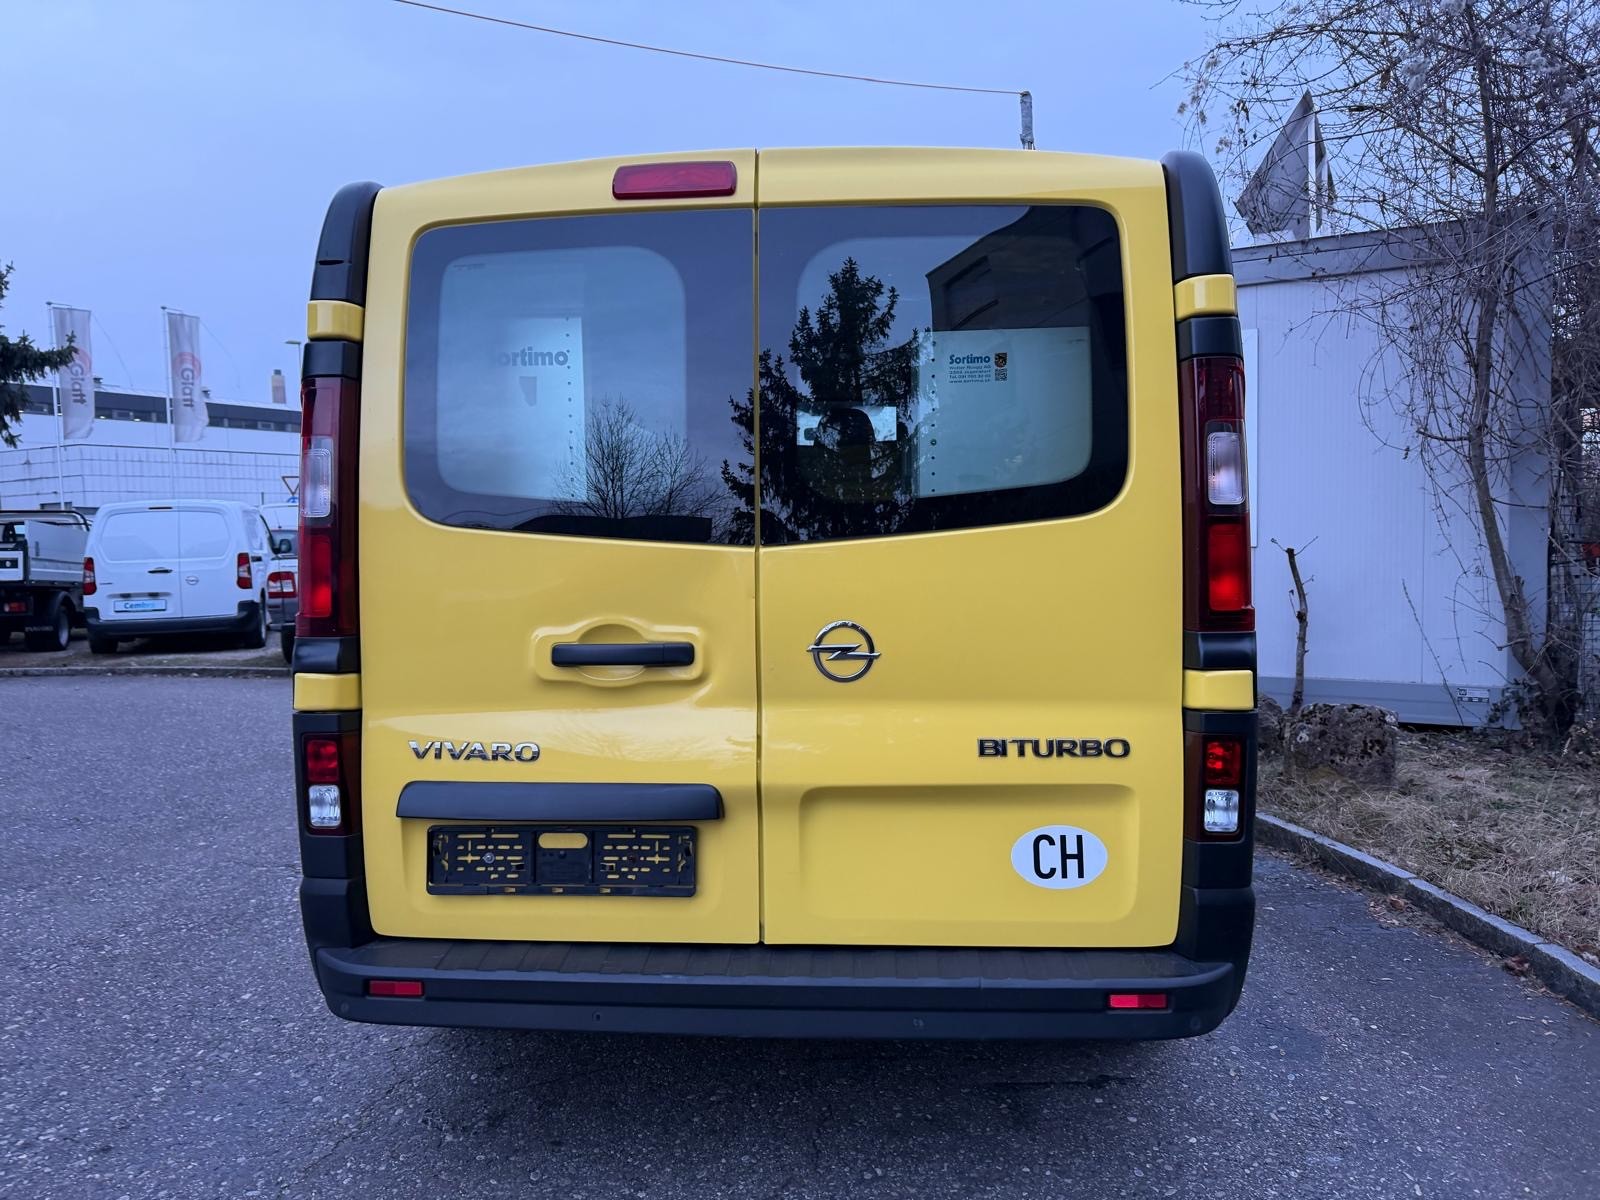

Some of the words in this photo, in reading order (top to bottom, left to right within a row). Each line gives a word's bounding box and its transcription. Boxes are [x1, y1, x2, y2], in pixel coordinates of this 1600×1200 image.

[496, 346, 568, 366] ortimo
[949, 354, 990, 364] Sortimo
[69, 361, 87, 405] Glatt
[180, 367, 195, 408] Glatt
[408, 740, 540, 762] VIVARO
[977, 738, 1131, 758] BITURBO
[1032, 834, 1085, 880] CH
